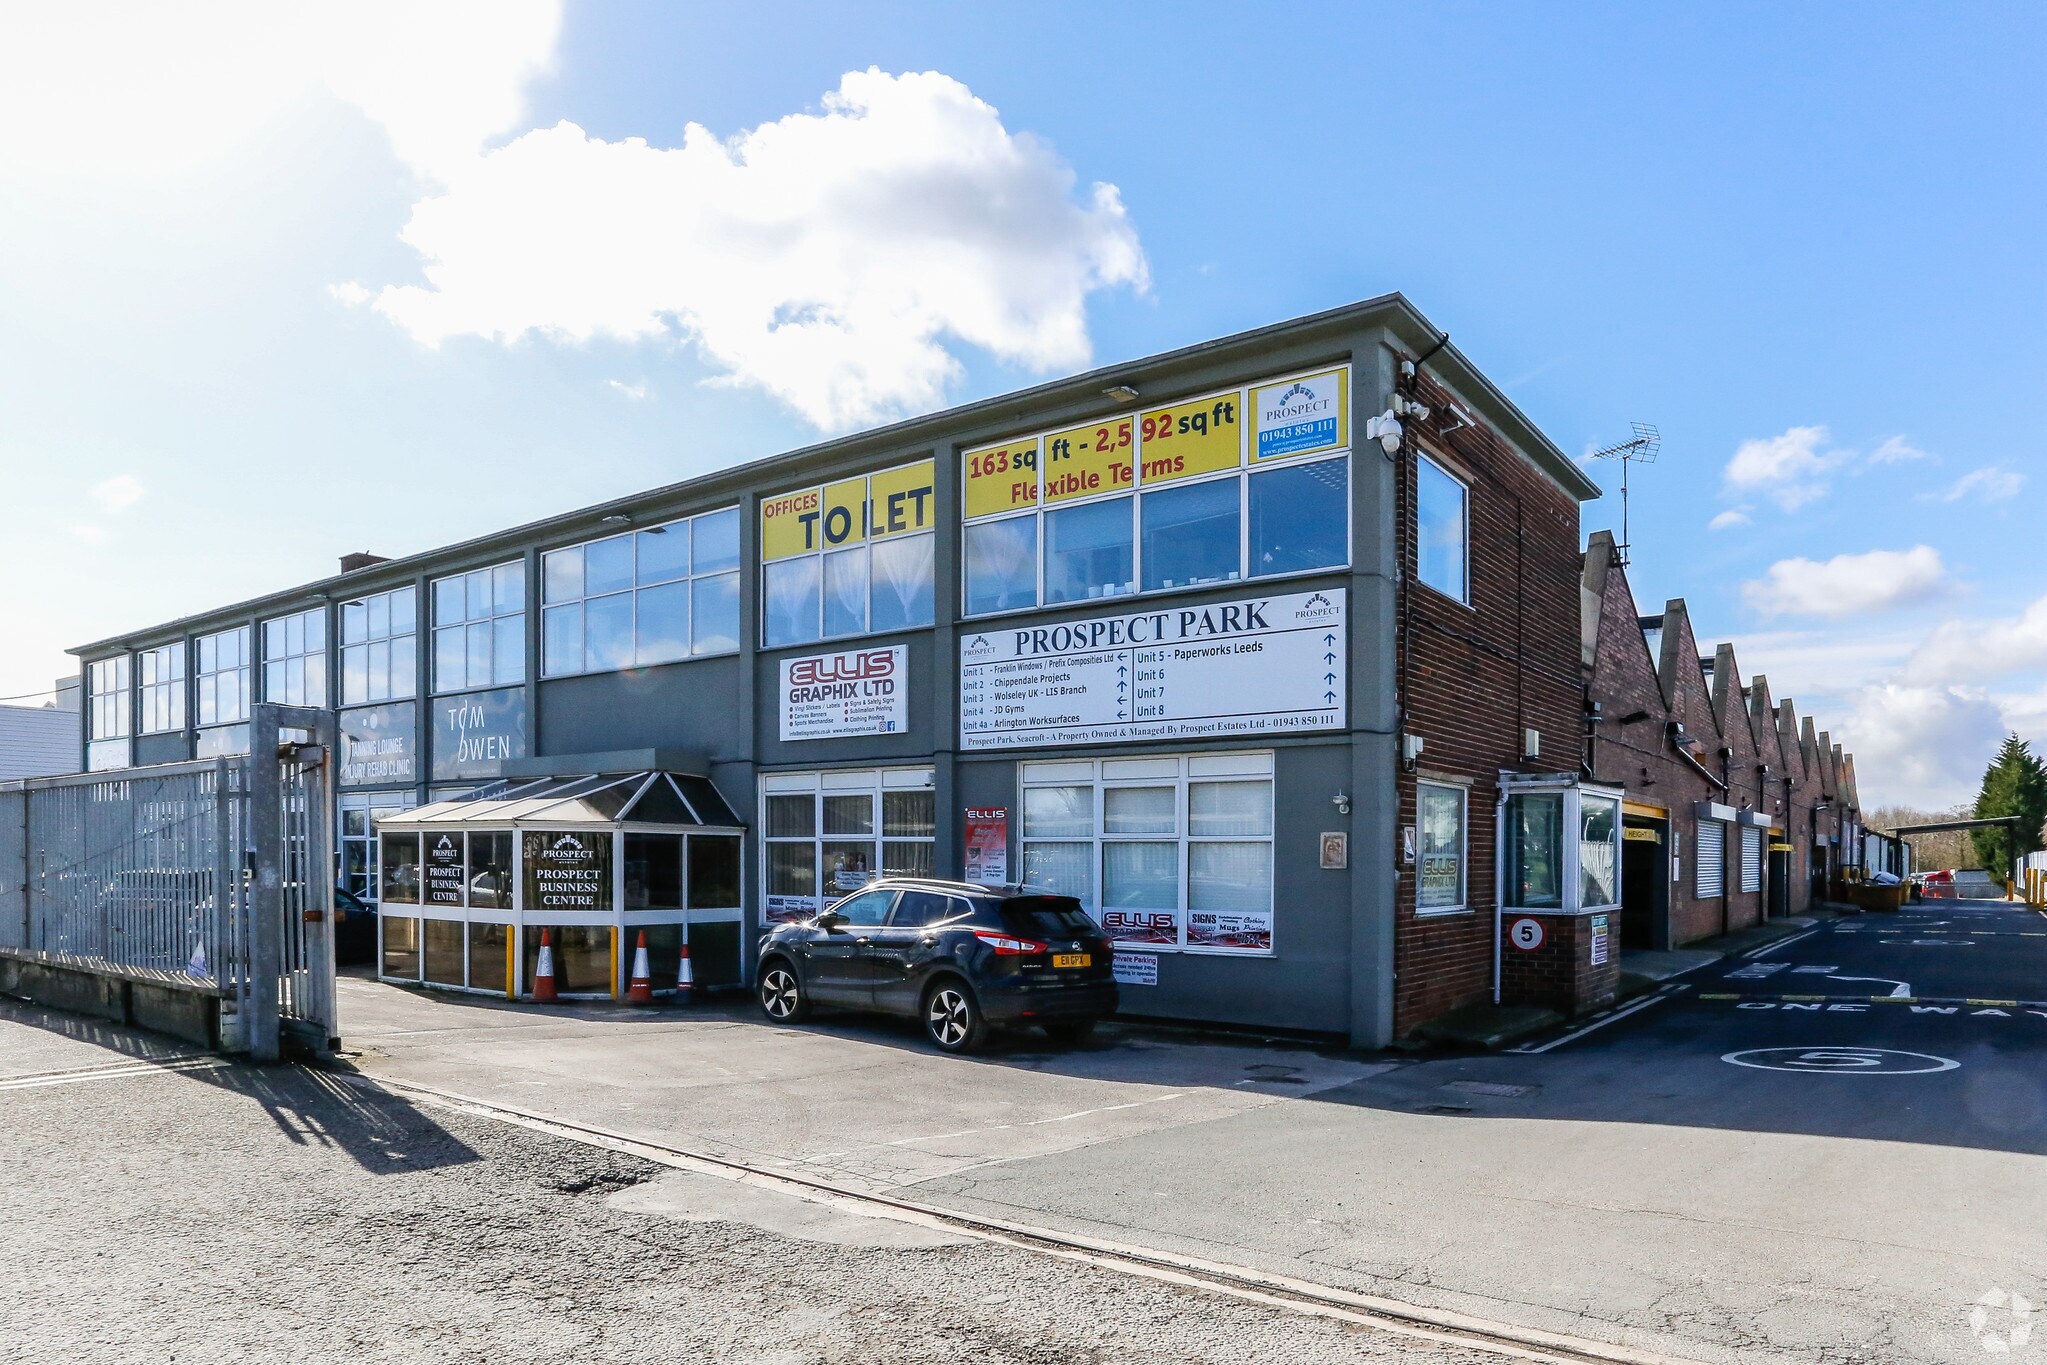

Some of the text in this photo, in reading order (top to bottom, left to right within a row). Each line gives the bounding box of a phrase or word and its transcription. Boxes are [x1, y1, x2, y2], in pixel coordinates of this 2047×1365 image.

[1266, 399, 1330, 421] PROSPECT
[1262, 428, 1292, 443] 01943
[1295, 423, 1314, 436] 850
[1318, 420, 1333, 432] 111
[970, 450, 1008, 478] 163
[1012, 450, 1038, 472] sq
[1052, 438, 1070, 462] ft
[1096, 414, 1172, 452] 2,592
[1178, 412, 1207, 436] sq
[1212, 402, 1234, 427] ft
[1012, 455, 1184, 503] Flexible Terms
[765, 493, 818, 518] OFFICES
[798, 486, 932, 549] TO LET
[1296, 606, 1340, 618] PROSPECT
[1014, 601, 1270, 656] PROSPECT PARK
[964, 646, 996, 656] PROSPECT
[1137, 652, 1156, 663] Unit
[1158, 650, 1164, 662] 5
[1174, 644, 1230, 661] Paperworks
[1234, 641, 1263, 654] Leeds
[790, 650, 894, 686] ELLIS
[964, 668, 978, 677] Unit
[980, 668, 984, 676] 1
[994, 663, 1016, 674] Franklin
[1018, 662, 1042, 672] Windows
[1048, 658, 1066, 668] Prefix
[1104, 654, 1114, 663] Ltd
[964, 681, 978, 690] Unit
[980, 680, 984, 689] 2
[994, 676, 1038, 691] Chippendale
[1040, 672, 1070, 684] Projects
[1137, 669, 1164, 681] Unit 6
[790, 679, 894, 703] GRAPHIX LTD
[964, 694, 978, 704] Unit
[979, 694, 984, 702] 3
[994, 688, 1026, 701] Wolseley
[1028, 688, 1038, 697] UK
[1061, 685, 1087, 695] Branch
[1137, 687, 1164, 699] Unit 7
[448, 700, 484, 730] TOM
[964, 708, 978, 717] Unit
[994, 706, 1003, 715] JD
[1005, 705, 1024, 715] Gyms
[1137, 704, 1164, 716] Unit 8
[964, 721, 978, 730] Unit
[980, 721, 988, 729] 4a
[994, 716, 1027, 729] Arlington
[1029, 714, 1080, 725] Worksurfaces
[968, 738, 995, 747] Prospect
[997, 736, 1016, 745] Park,
[1016, 734, 1045, 743] Seacroft
[1050, 732, 1057, 740] A
[1058, 731, 1089, 742] Property
[1091, 728, 1118, 738] Owned
[1128, 726, 1165, 736] Managed
[1167, 725, 1178, 735] By
[1180, 723, 1215, 734] Prospect
[1217, 721, 1247, 730] Estates
[1250, 719, 1265, 729] Ltd
[1273, 717, 1299, 727] 01943
[1301, 716, 1317, 726] 850
[1320, 715, 1334, 724] 111
[351, 738, 403, 757] TANNING LOUNGE
[458, 735, 510, 763] OWEN
[367, 761, 387, 777] REHAB
[389, 759, 410, 775] CLINIC
[430, 868, 460, 877] PROSPECT
[536, 869, 600, 879] PROSPECT
[1423, 858, 1456, 875] ELLIS
[432, 880, 459, 889] BUSINESS
[539, 882, 598, 892] BUSINESS
[433, 892, 458, 901] CENTRE
[543, 896, 594, 905] CENTRE
[1104, 912, 1173, 928] ELLIS
[1192, 914, 1216, 924] SIGNS
[1521, 926, 1533, 942] 5
[1071, 956, 1084, 964] GPX
[1134, 957, 1156, 965] Parking
[1736, 1003, 1871, 1012] ONE
[1784, 1052, 1882, 1066] 5
